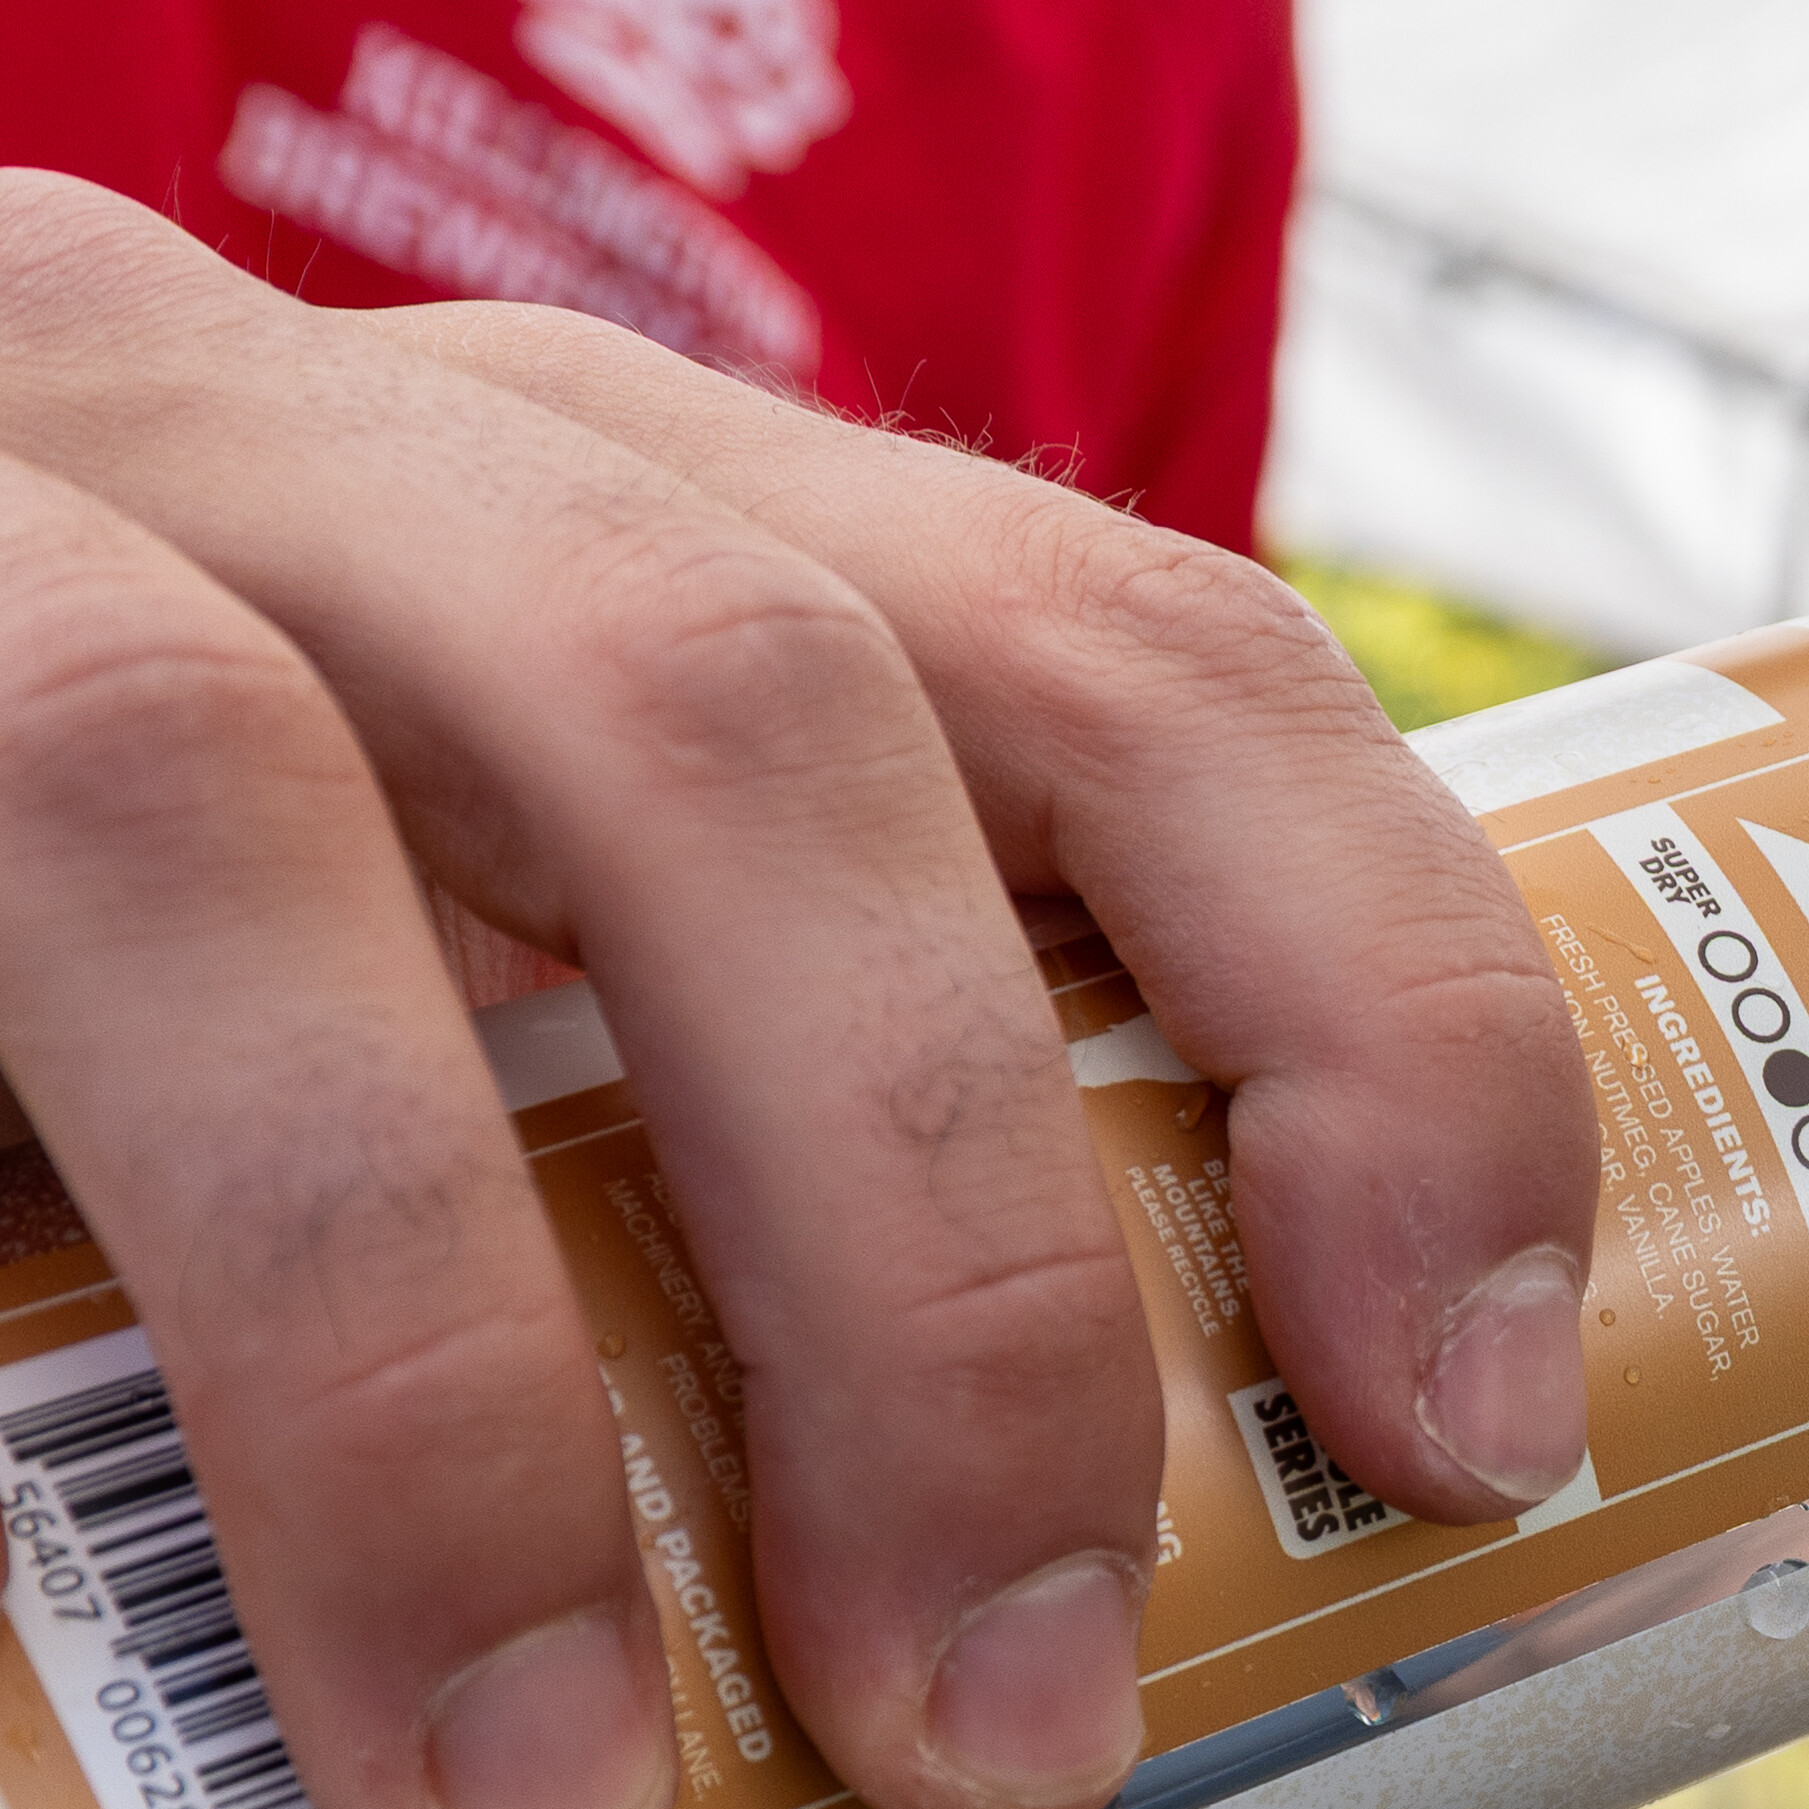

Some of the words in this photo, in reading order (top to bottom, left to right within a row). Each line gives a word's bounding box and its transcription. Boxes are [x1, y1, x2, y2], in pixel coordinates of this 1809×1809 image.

[1639, 856, 1692, 905] DRY
[1651, 837, 1721, 918] SUPER
[1540, 914, 1605, 992] FRESH
[1594, 995, 1672, 1119] PRESSED
[1712, 1245, 1760, 1349] WATER
[1634, 974, 1770, 1237] INGREDIENTS:
[1126, 1166, 1176, 1243] PLEASE
[1168, 1244, 1222, 1337] RECYCLE
[1152, 1163, 1241, 1326] MOUNTAINS.
[1188, 1178, 1229, 1237] LIKE
[1220, 1241, 1250, 1293] THE
[1585, 1050, 1657, 1177] NUTMEG,
[1650, 1182, 1697, 1265] CANE
[1682, 1271, 1732, 1382] SUGAR,
[1617, 1194, 1674, 1319] VANILLA.
[1253, 1392, 1340, 1542] SERIES
[620, 1433, 674, 1522] AND
[655, 1526, 774, 1763] PACKAGED
